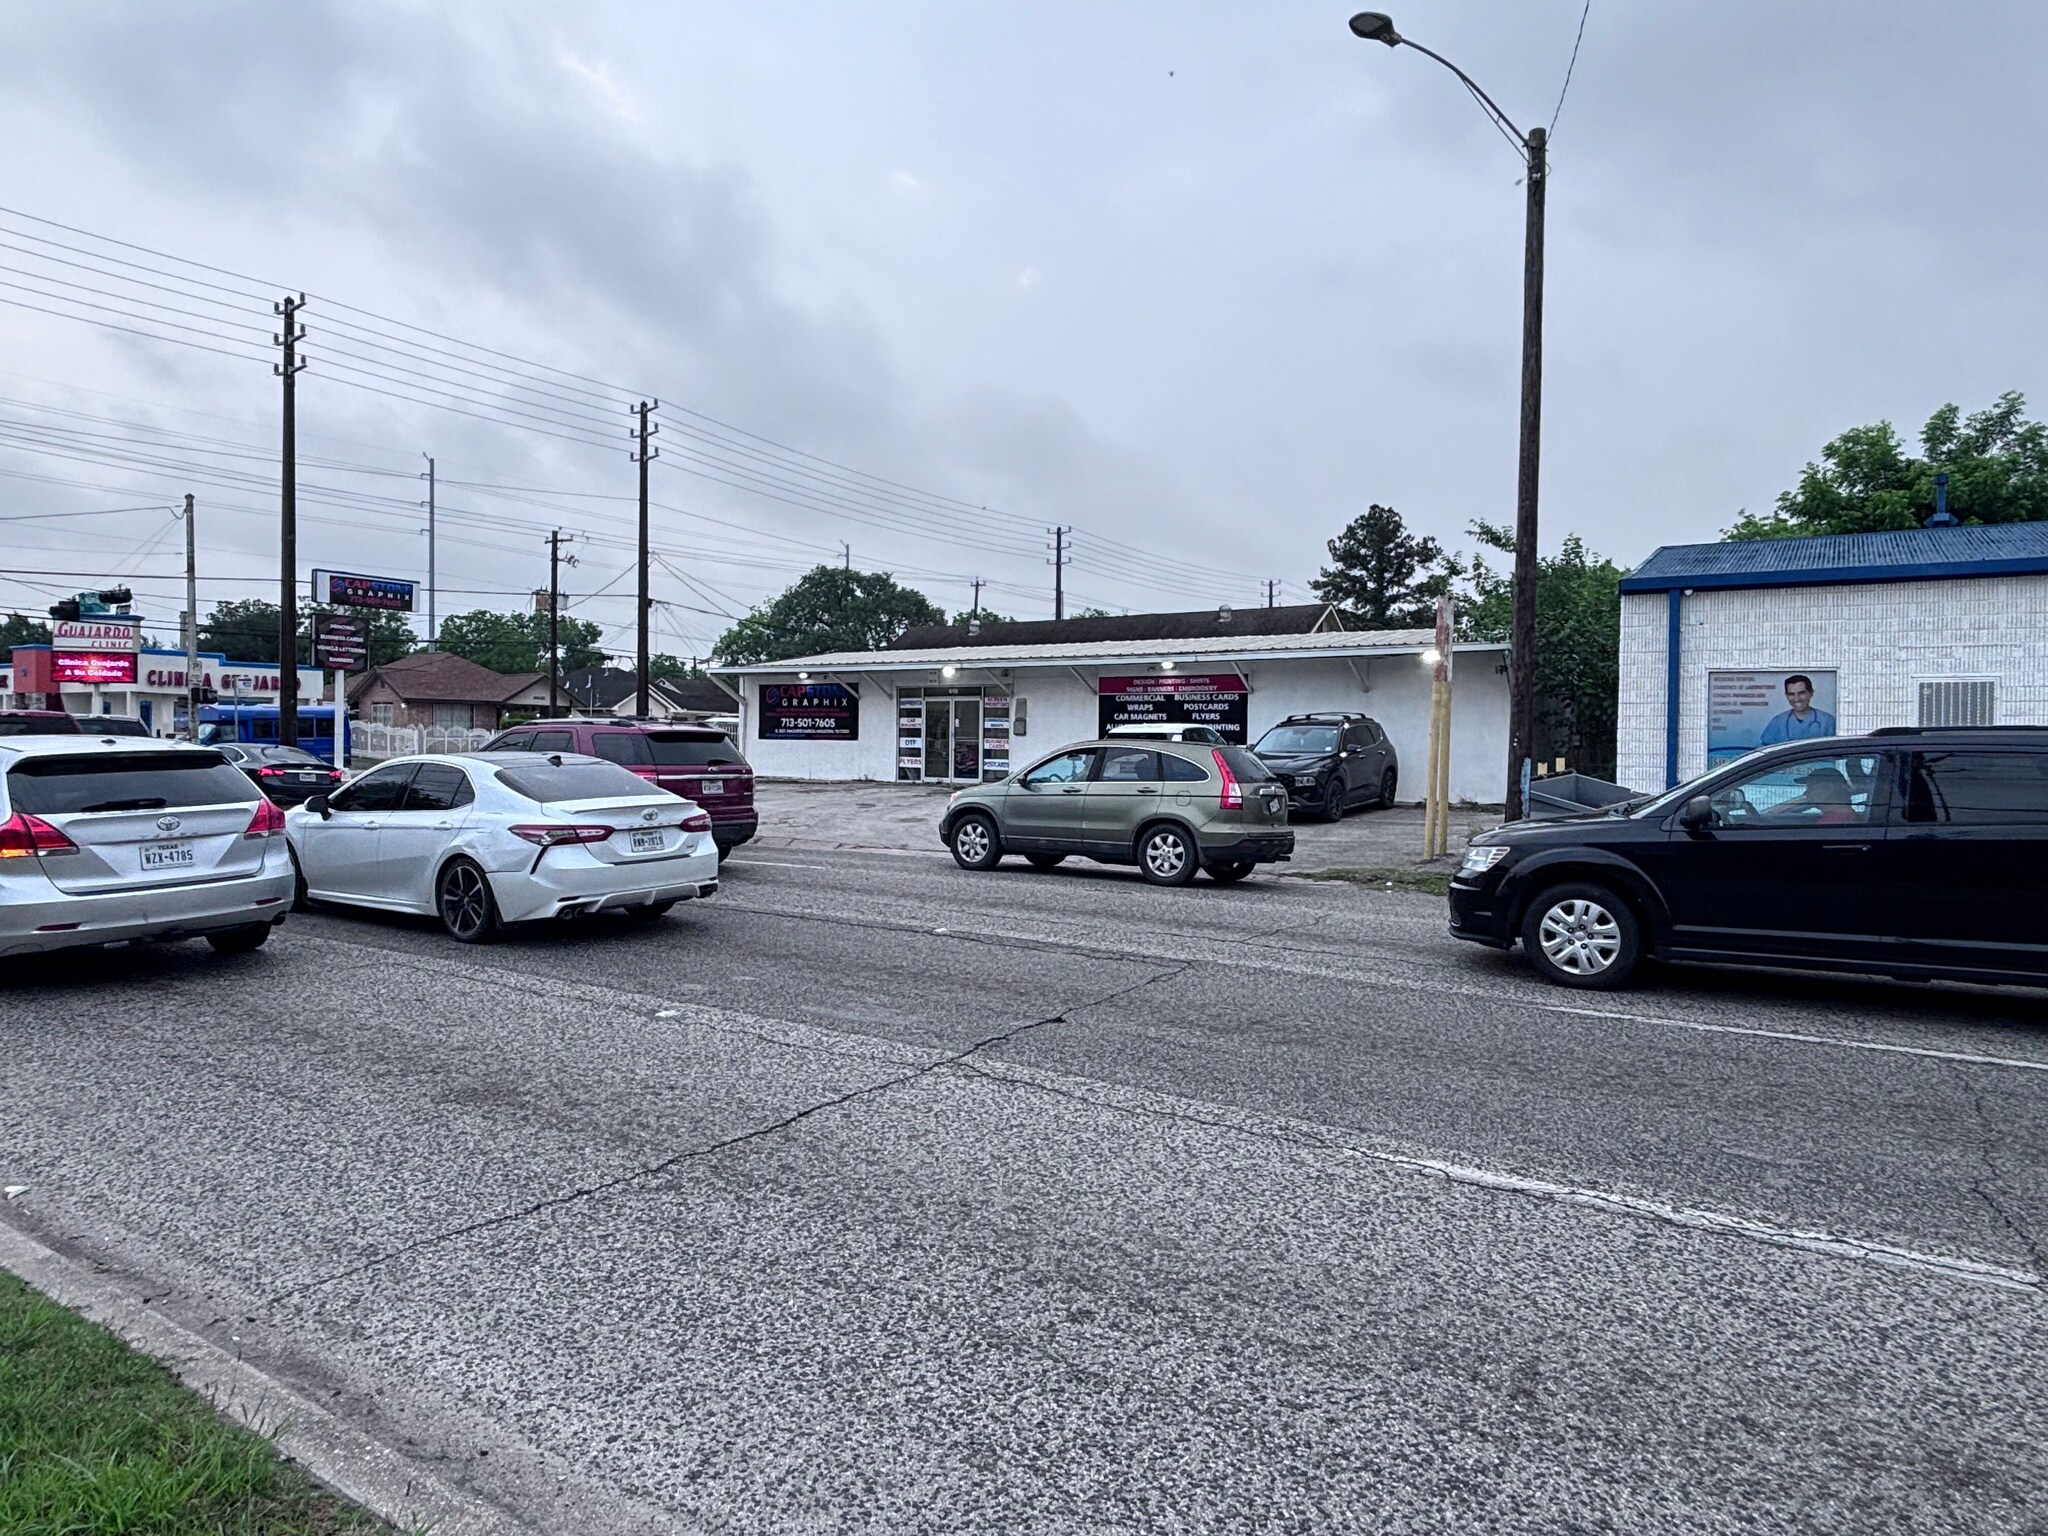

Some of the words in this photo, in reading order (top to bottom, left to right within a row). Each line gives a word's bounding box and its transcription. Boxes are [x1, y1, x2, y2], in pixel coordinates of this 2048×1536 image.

[346, 588, 410, 601] GRAPHIX
[91, 640, 130, 649] CLINIC
[1115, 694, 1167, 702] COMMERCIAL
[1174, 693, 1211, 701] BUSINESS
[1212, 693, 1240, 701] CARDS
[781, 698, 848, 706] GRAPHIX
[1183, 702, 1229, 710] POSTCARDS
[1127, 703, 1154, 711] WRAPS
[1130, 713, 1168, 721] MAGNETS
[1192, 712, 1221, 720] FLYERS
[781, 718, 836, 728] 713-501-7605
